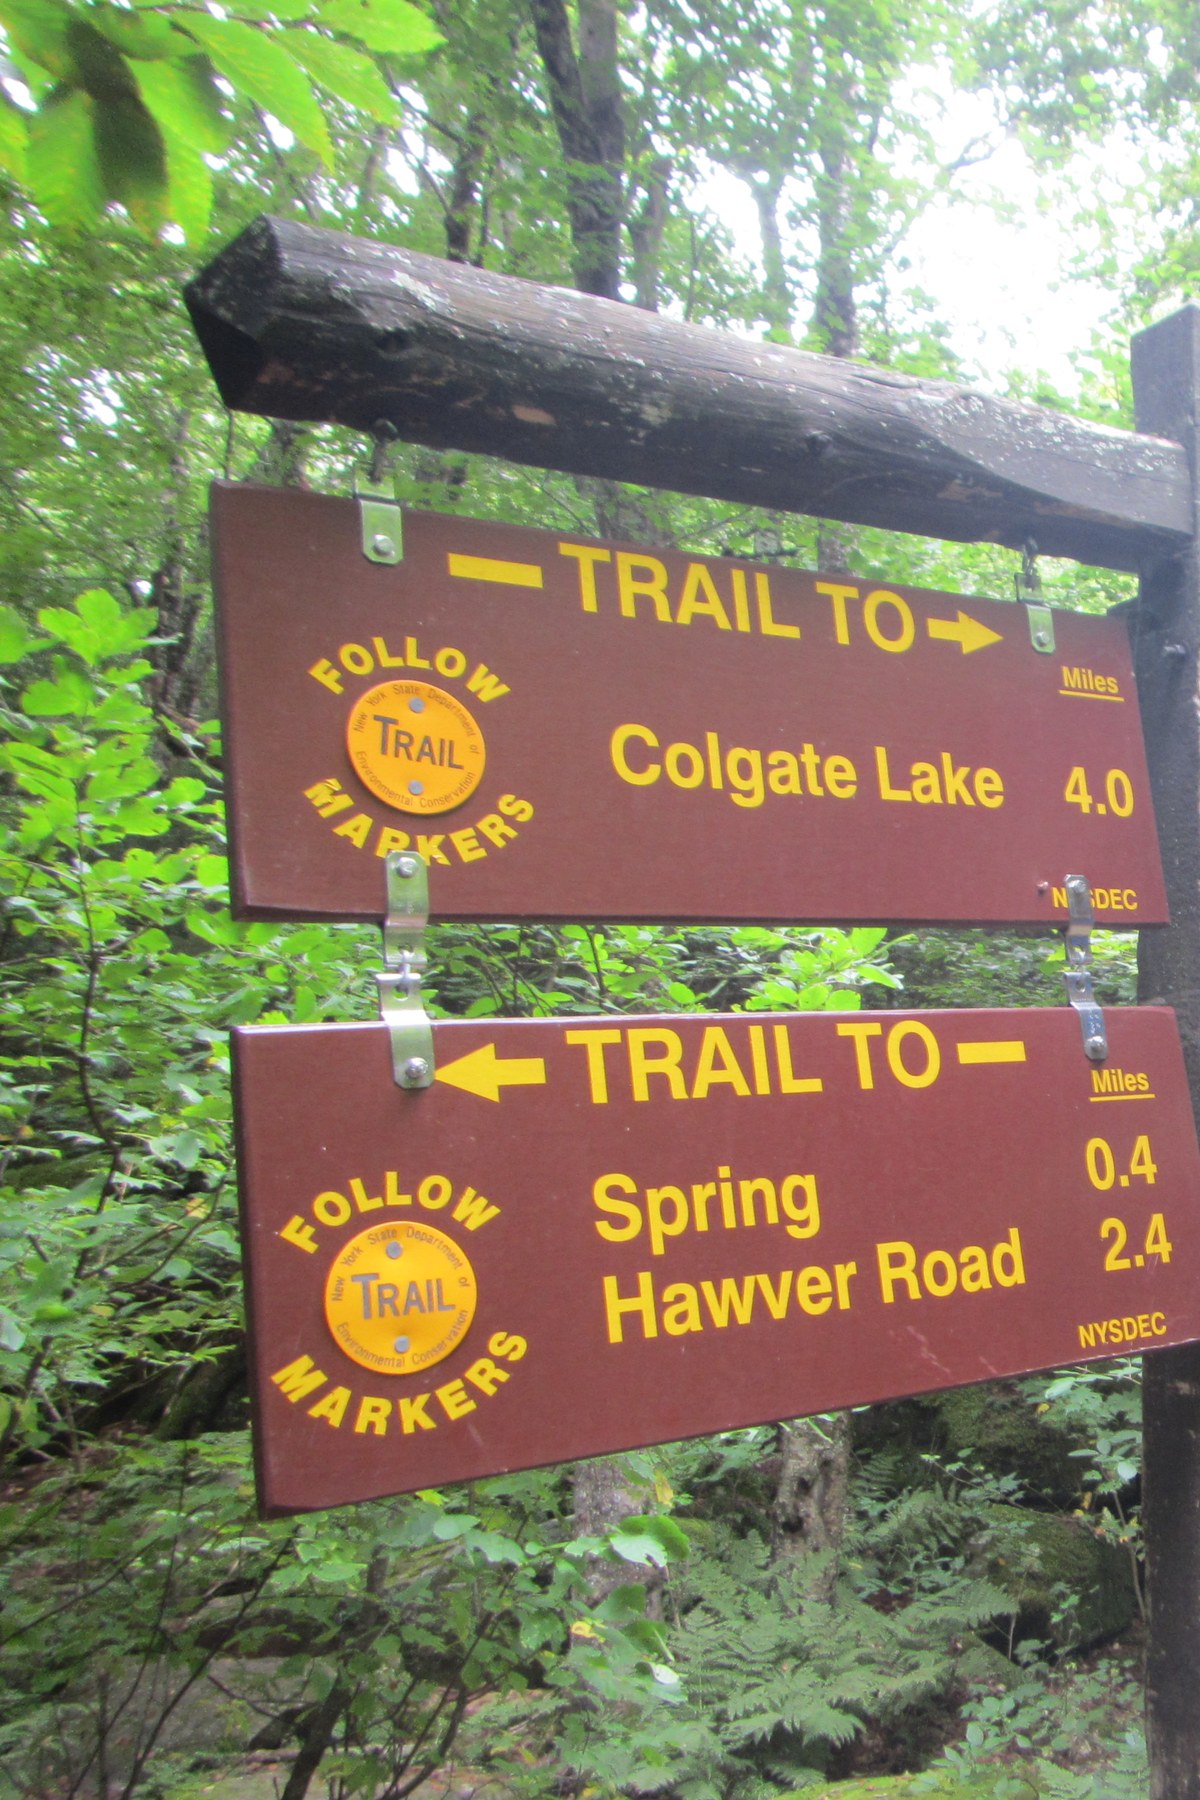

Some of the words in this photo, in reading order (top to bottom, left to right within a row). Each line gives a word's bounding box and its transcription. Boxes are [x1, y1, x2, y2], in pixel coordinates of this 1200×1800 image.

[558, 542, 800, 639] TRAIL
[815, 581, 916, 653] TO
[308, 636, 511, 703] FOLLOW
[1062, 666, 1119, 694] Miles
[373, 714, 465, 770] TRAIL
[609, 723, 857, 808] Colgate
[874, 746, 1004, 808] Lake
[1063, 767, 1135, 818] 4.0
[303, 778, 535, 866] MARKERS
[1052, 886, 1138, 910] NDEC
[565, 1025, 823, 1104] TRAIL
[836, 1020, 941, 1090] TO
[1091, 1069, 1150, 1093] Miles
[1085, 1135, 1158, 1191] 0.4
[279, 1171, 501, 1254] FOLLOW
[593, 1166, 820, 1256] Spring
[1100, 1213, 1173, 1271] 2.4
[332, 1276, 345, 1301] New
[351, 1273, 456, 1319] TRAIL
[602, 1261, 857, 1344] Hawver
[876, 1228, 1026, 1304] Road
[412, 1309, 468, 1364] Conservation
[1078, 1311, 1167, 1348] NYSDEC
[271, 1331, 528, 1435] MARKERS
